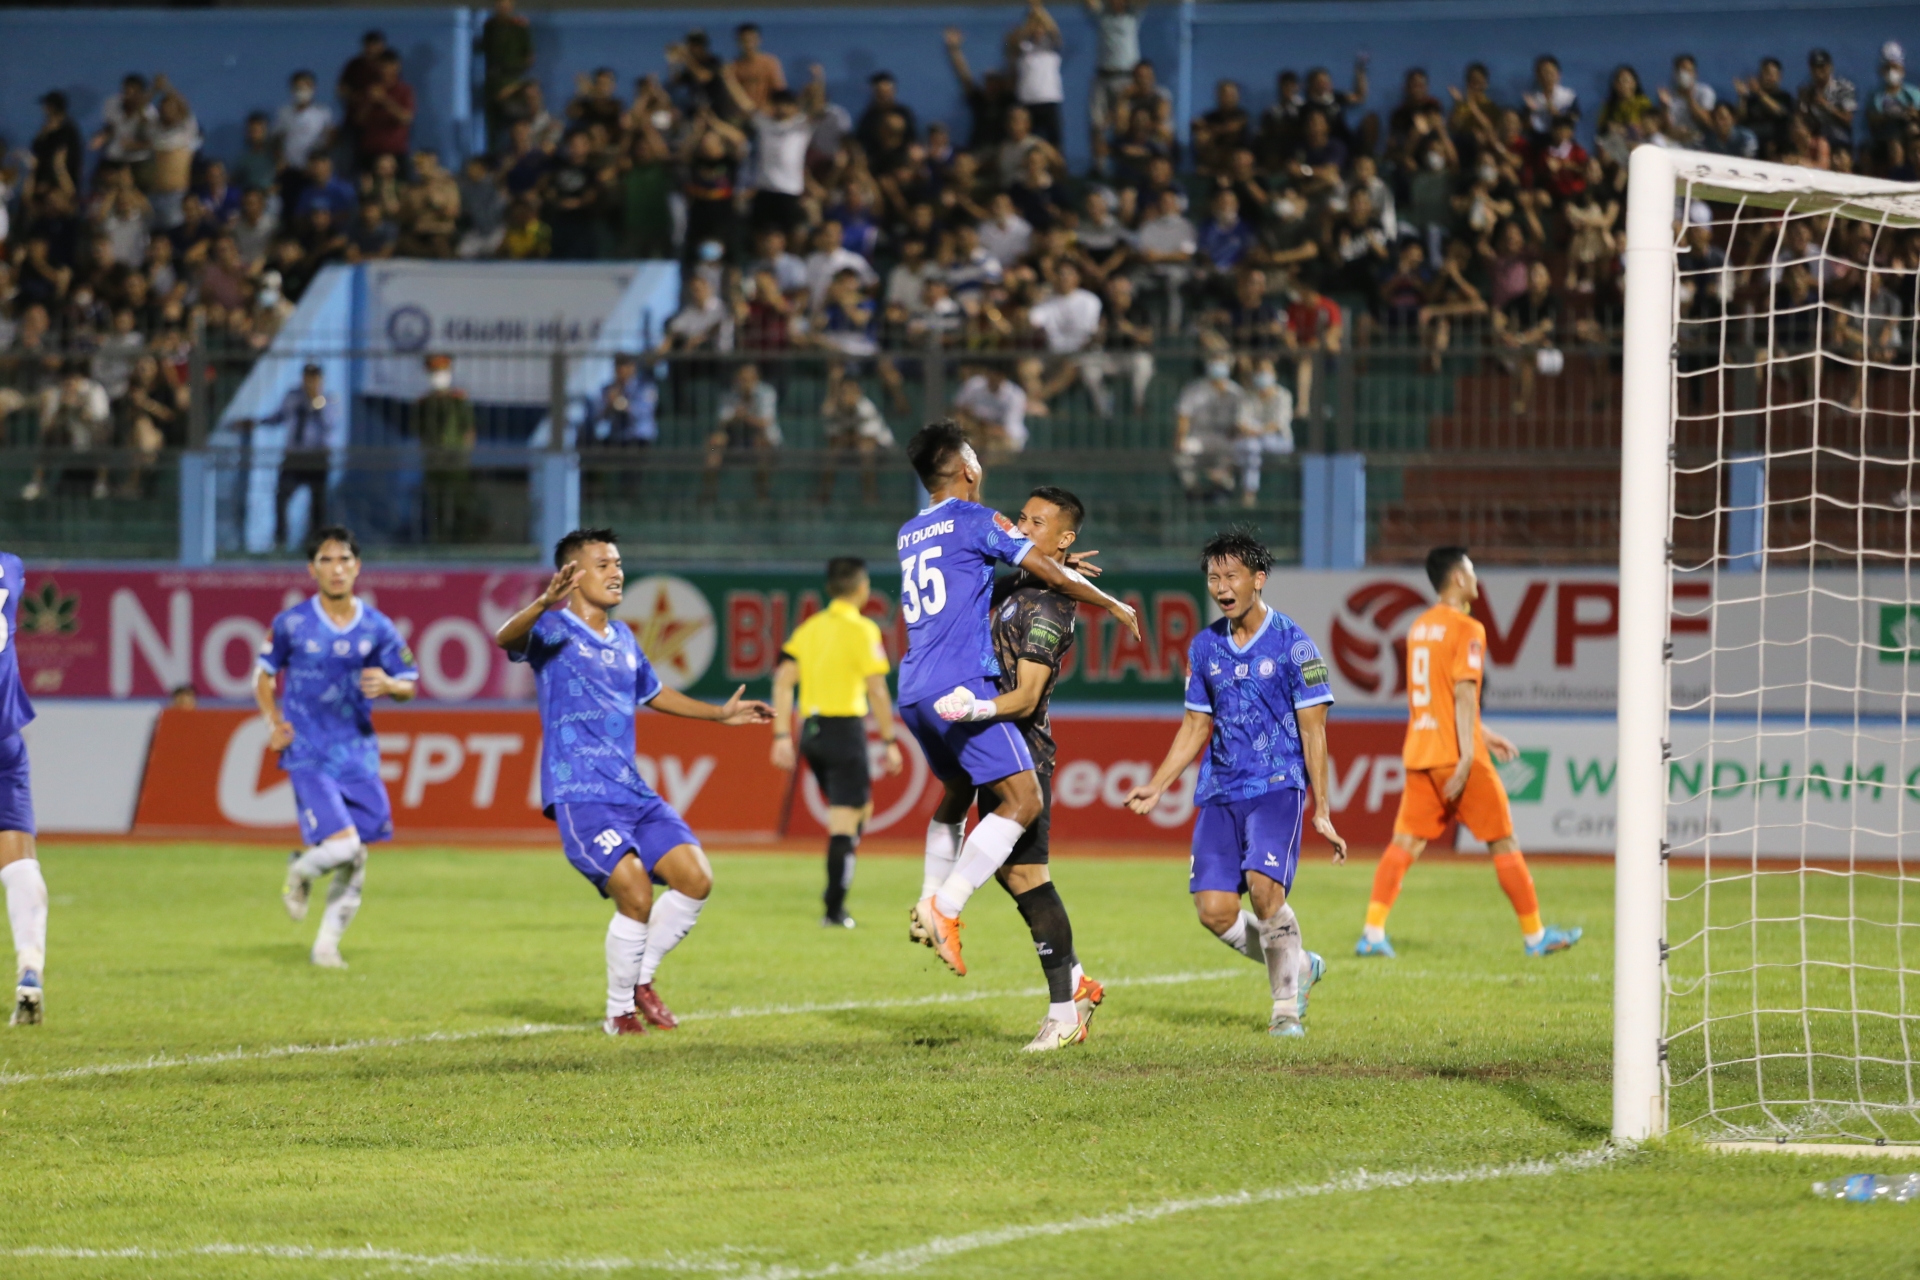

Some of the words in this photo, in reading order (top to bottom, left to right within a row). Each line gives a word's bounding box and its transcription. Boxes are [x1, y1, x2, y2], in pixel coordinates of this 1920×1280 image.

[901, 546, 947, 624] 35
[1474, 582, 1711, 669] VPF
[1411, 646, 1431, 707] 9
[1567, 756, 1886, 800] WNDHAM
[593, 828, 623, 856] 30
